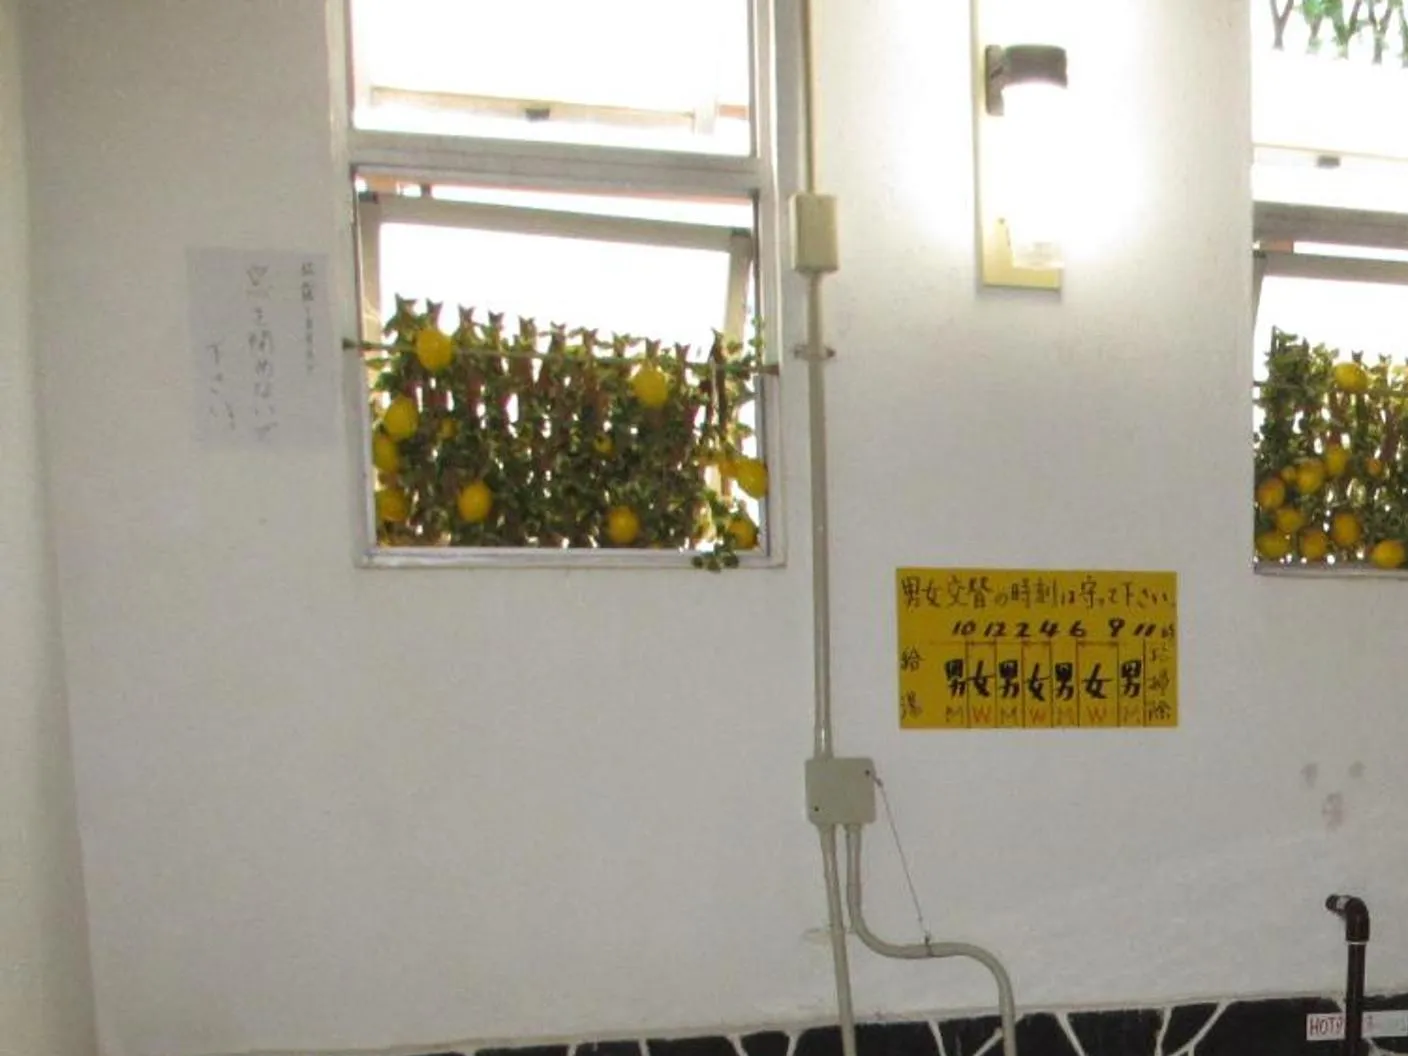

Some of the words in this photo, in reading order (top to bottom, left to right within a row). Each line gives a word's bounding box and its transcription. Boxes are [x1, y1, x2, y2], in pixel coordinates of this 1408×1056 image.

[952, 620, 977, 636] 10
[984, 621, 1007, 637] 12
[1015, 621, 1031, 637] 2
[1039, 619, 1059, 637] 4
[1070, 619, 1087, 637] 6
[1134, 623, 1157, 637] 11
[944, 656, 967, 697] 男
[966, 659, 995, 698] 女
[998, 657, 1020, 698] 男
[1025, 661, 1050, 702] 女
[1054, 662, 1074, 702] 男
[1081, 662, 1113, 700] 女
[1120, 659, 1142, 698] 男
[972, 703, 992, 723] W
[1000, 705, 1018, 724] M
[1029, 705, 1048, 724] W
[1087, 705, 1108, 724] W
